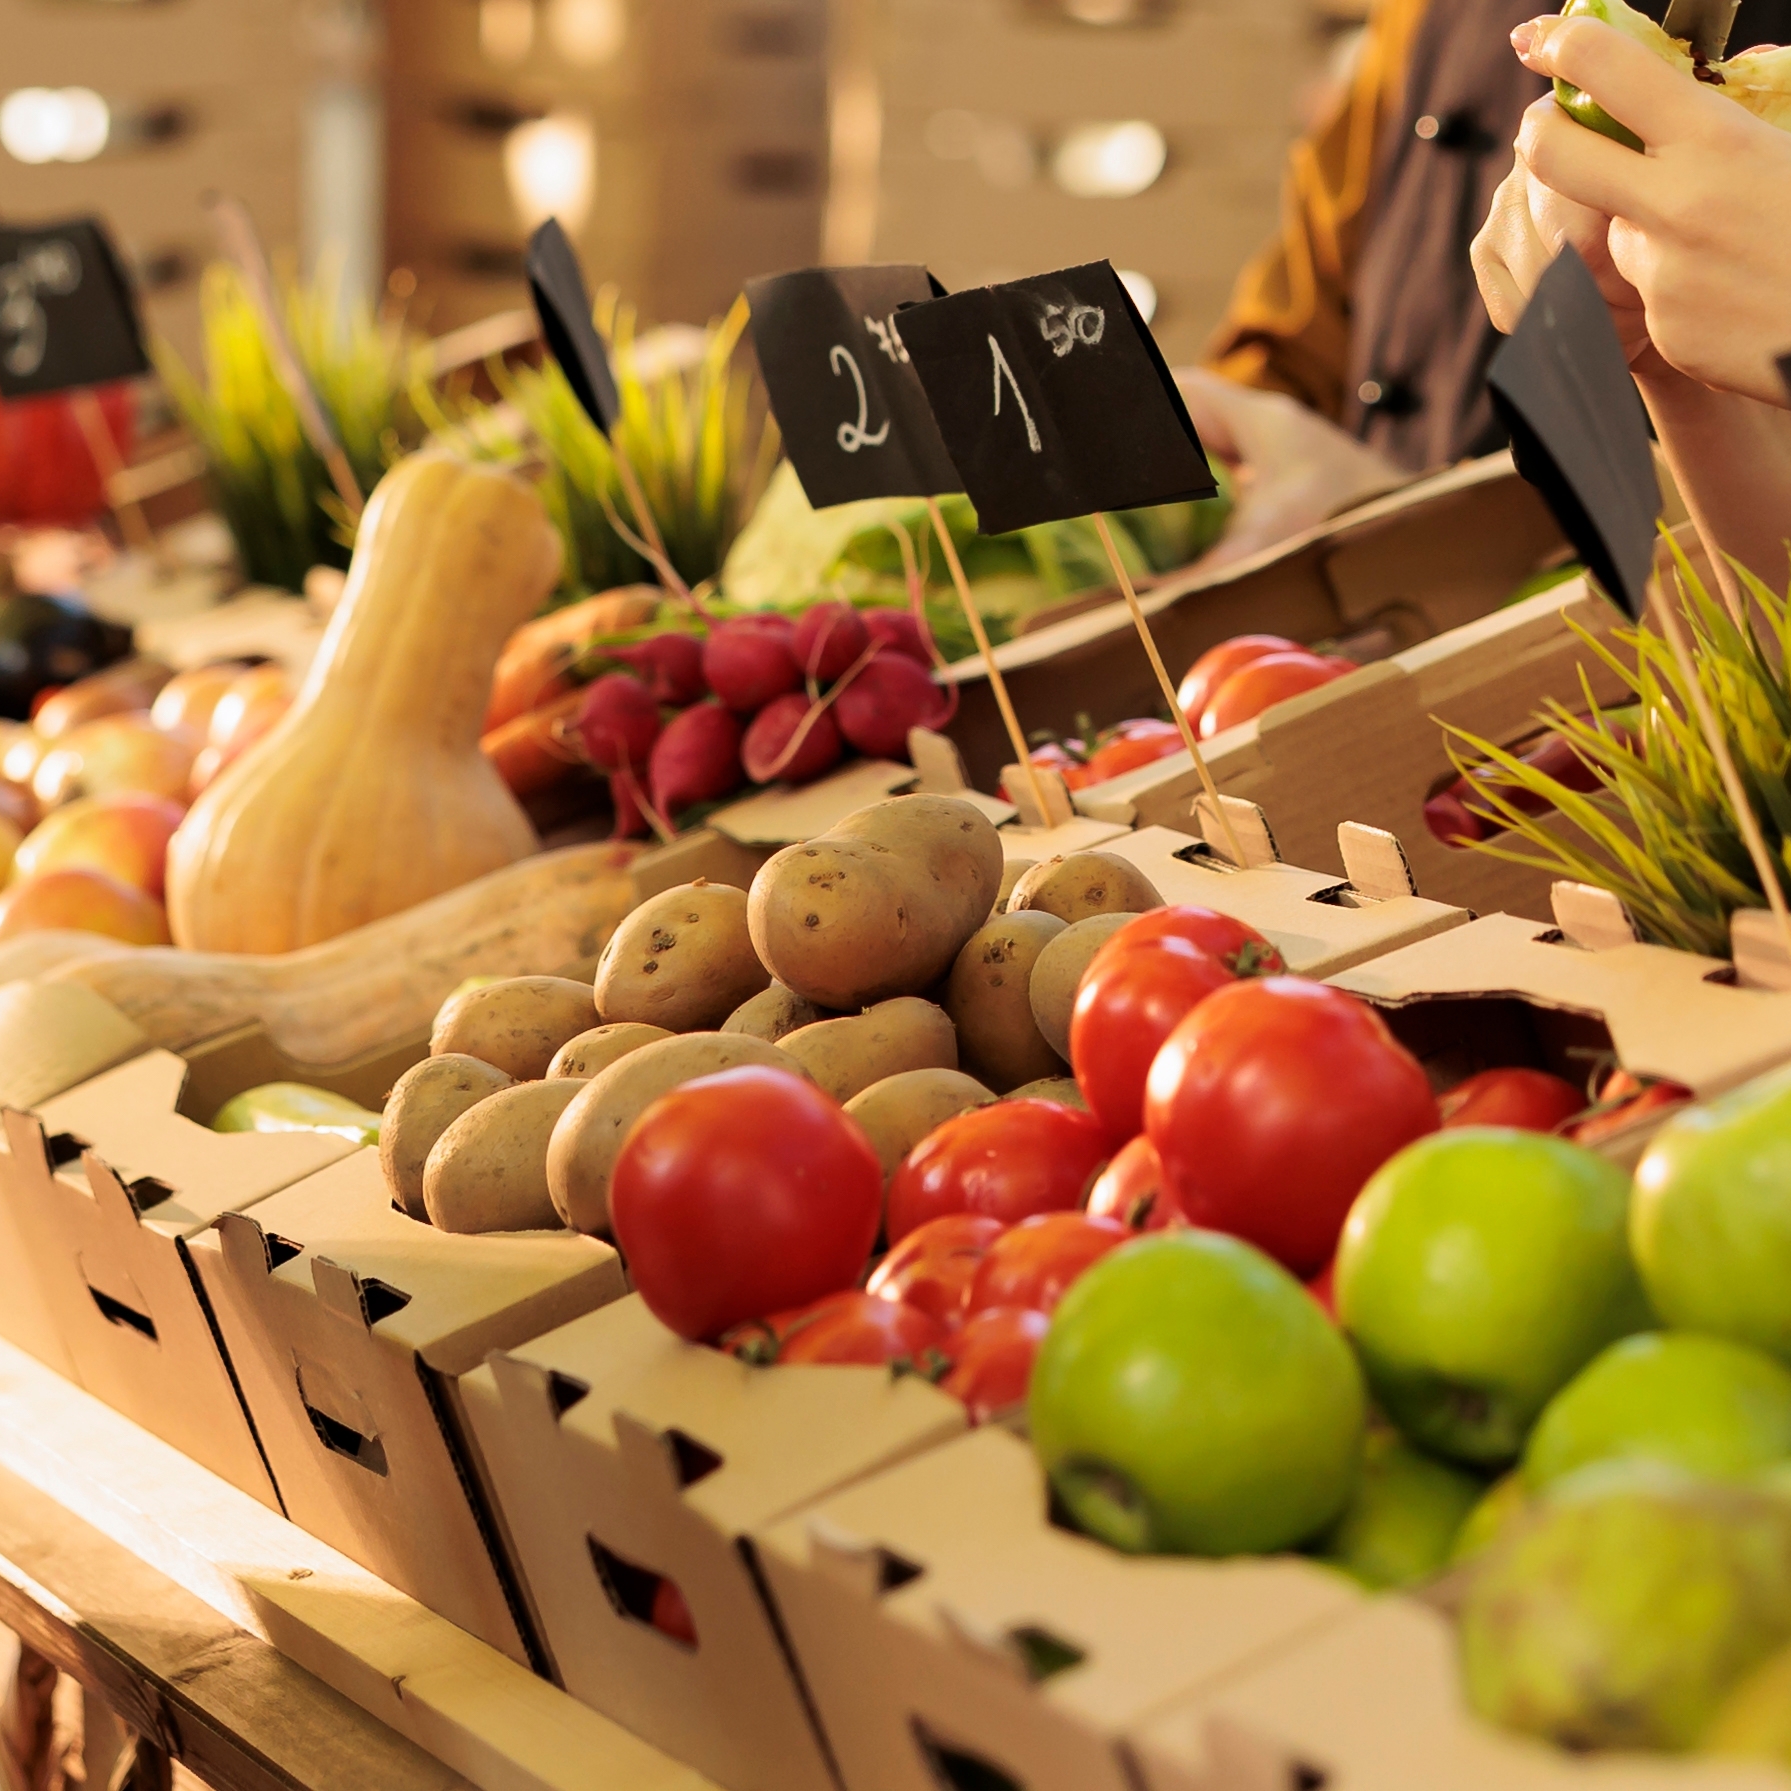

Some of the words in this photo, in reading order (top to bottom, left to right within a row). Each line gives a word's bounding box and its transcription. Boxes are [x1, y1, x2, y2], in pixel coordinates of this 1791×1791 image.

[830, 344, 890, 453] 2
[988, 334, 1042, 453] 1
[1039, 304, 1105, 358] 50
